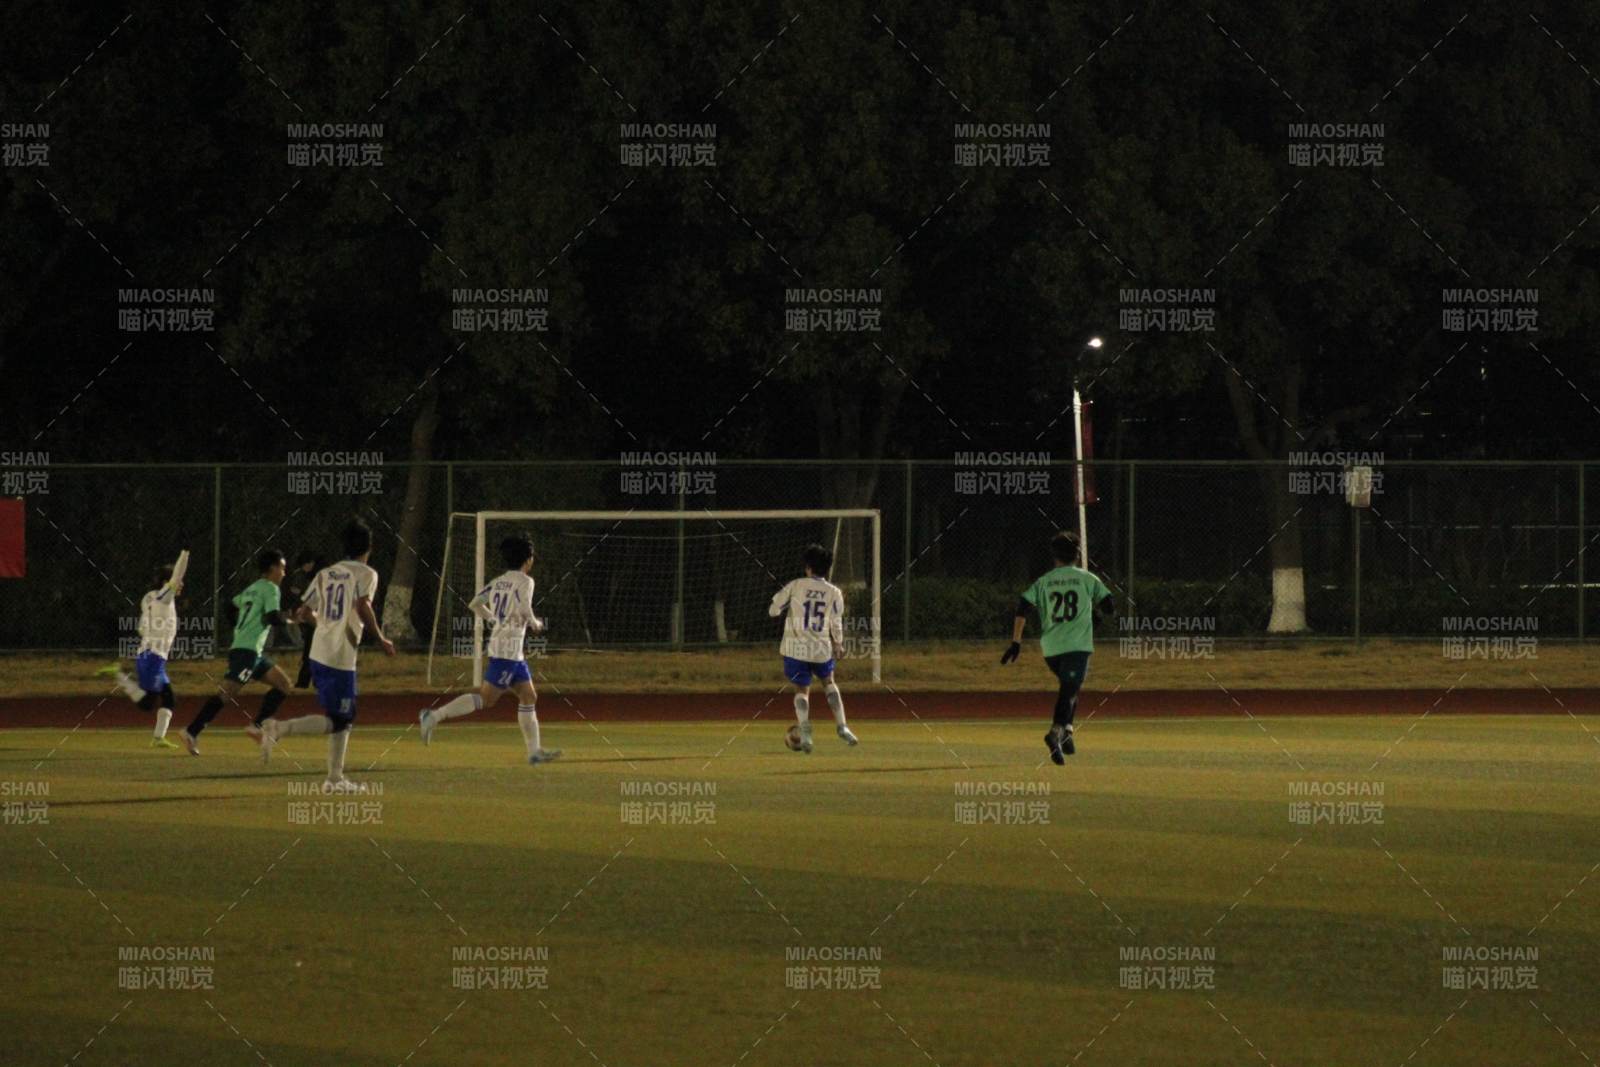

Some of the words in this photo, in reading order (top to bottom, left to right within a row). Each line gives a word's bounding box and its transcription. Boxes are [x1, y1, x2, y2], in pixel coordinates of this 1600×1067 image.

[326, 583, 345, 620] 19
[806, 590, 826, 599] ZZY
[1051, 590, 1079, 623] 28
[803, 600, 826, 632] 15
[498, 670, 513, 686] 24
